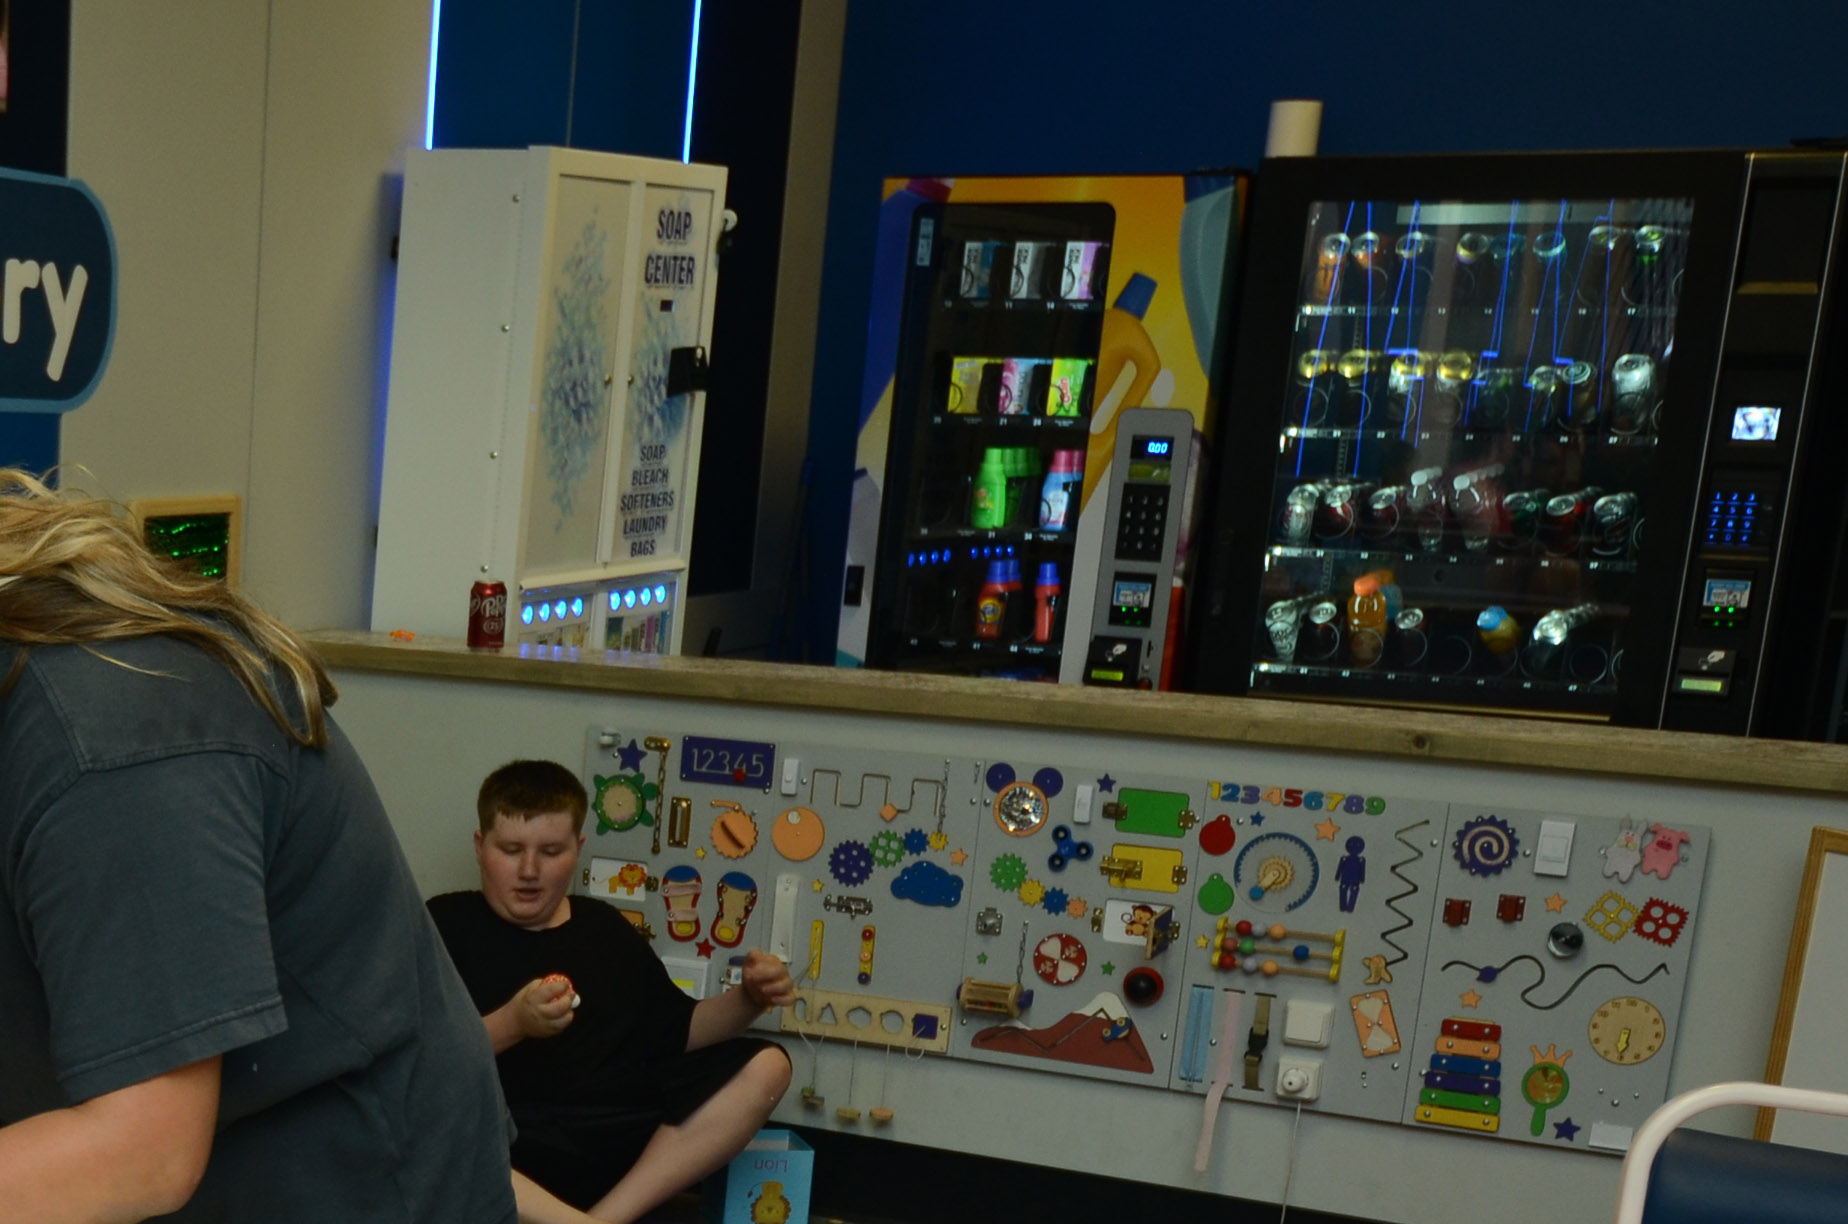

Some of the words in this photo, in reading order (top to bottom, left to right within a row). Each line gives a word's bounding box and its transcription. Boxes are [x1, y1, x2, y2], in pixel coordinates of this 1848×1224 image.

[657, 208, 693, 241] SOAP
[644, 252, 696, 286] CENTER
[640, 444, 666, 462] SOAP
[632, 467, 670, 487] BLEACH
[620, 490, 675, 512] SOFTENERS
[623, 515, 668, 535] LAUNDRY
[630, 539, 656, 558] BAGS
[754, 1158, 789, 1172] Lion
